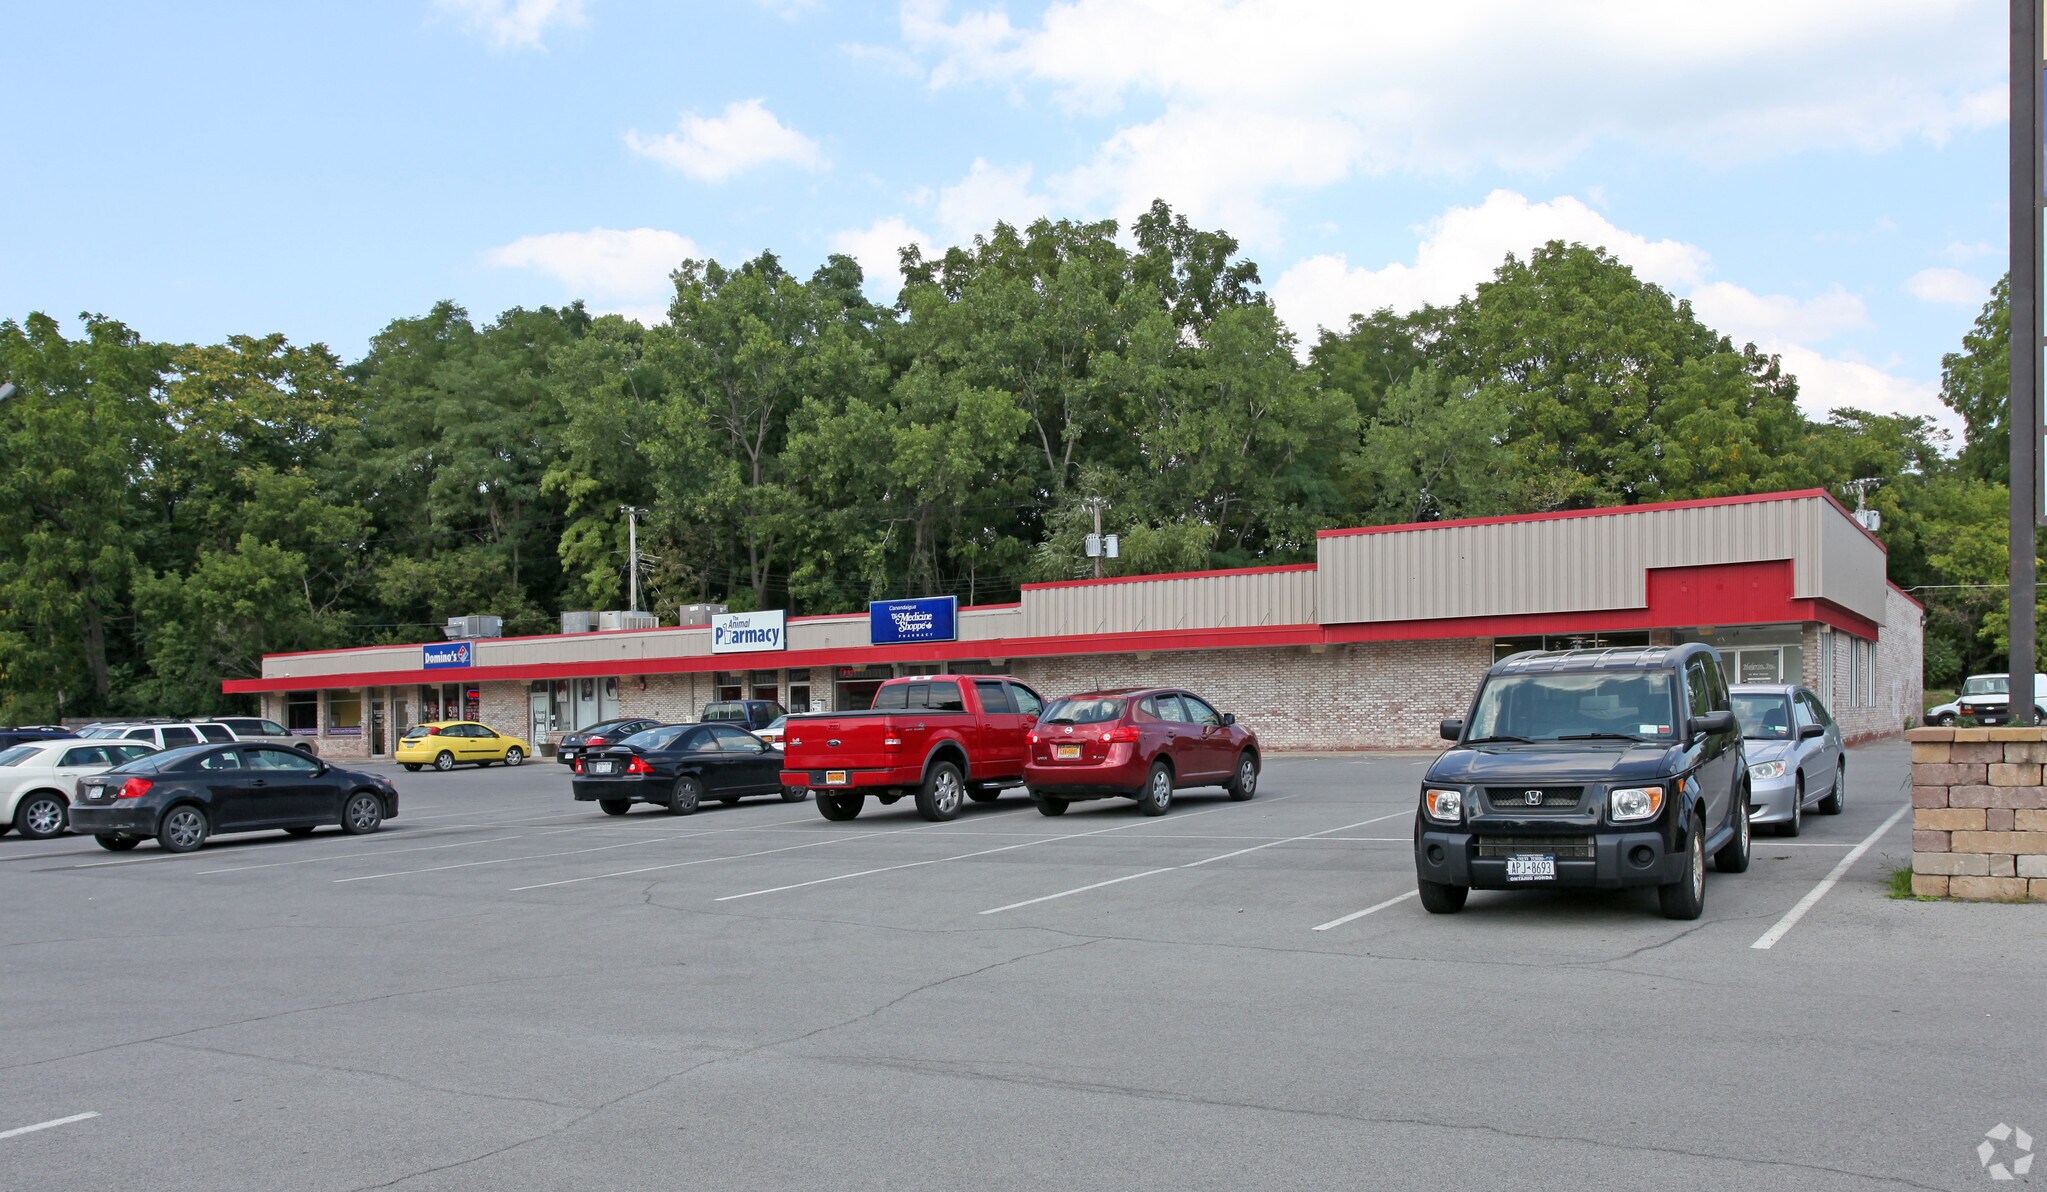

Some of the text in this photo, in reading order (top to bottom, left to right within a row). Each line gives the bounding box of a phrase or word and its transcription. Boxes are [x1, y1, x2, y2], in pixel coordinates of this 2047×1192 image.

[728, 618, 751, 629] Animal
[896, 611, 933, 624] Medicine
[898, 621, 926, 632] Shoppe
[425, 651, 457, 664] Domino's
